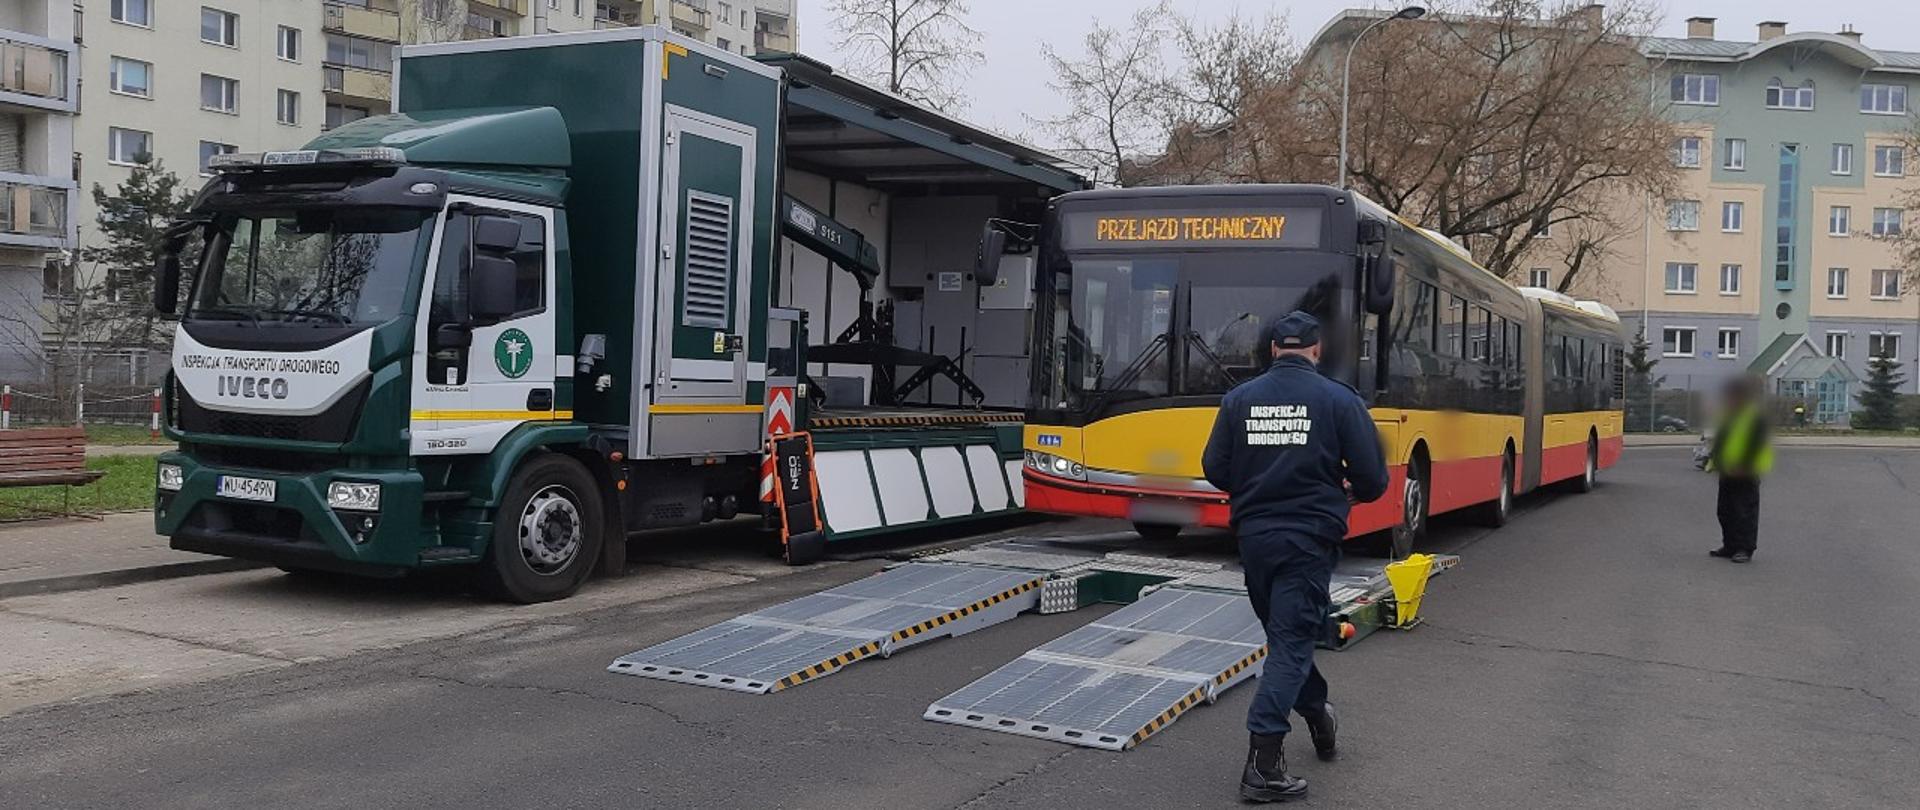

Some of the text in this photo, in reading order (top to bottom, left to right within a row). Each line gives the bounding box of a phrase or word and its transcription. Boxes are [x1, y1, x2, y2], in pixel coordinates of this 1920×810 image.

[1097, 215, 1286, 241] PRZEJAZD TECHNICZNY
[181, 354, 340, 376] INSPEKCJA TRANSPORTU DROGOWEGO
[218, 375, 289, 400] IVECO
[1250, 405, 1307, 418] INSPEKCJA
[1245, 418, 1311, 432] TRANSPORTU
[1247, 432, 1308, 445] DROGOWEGO
[788, 455, 799, 490] NEO
